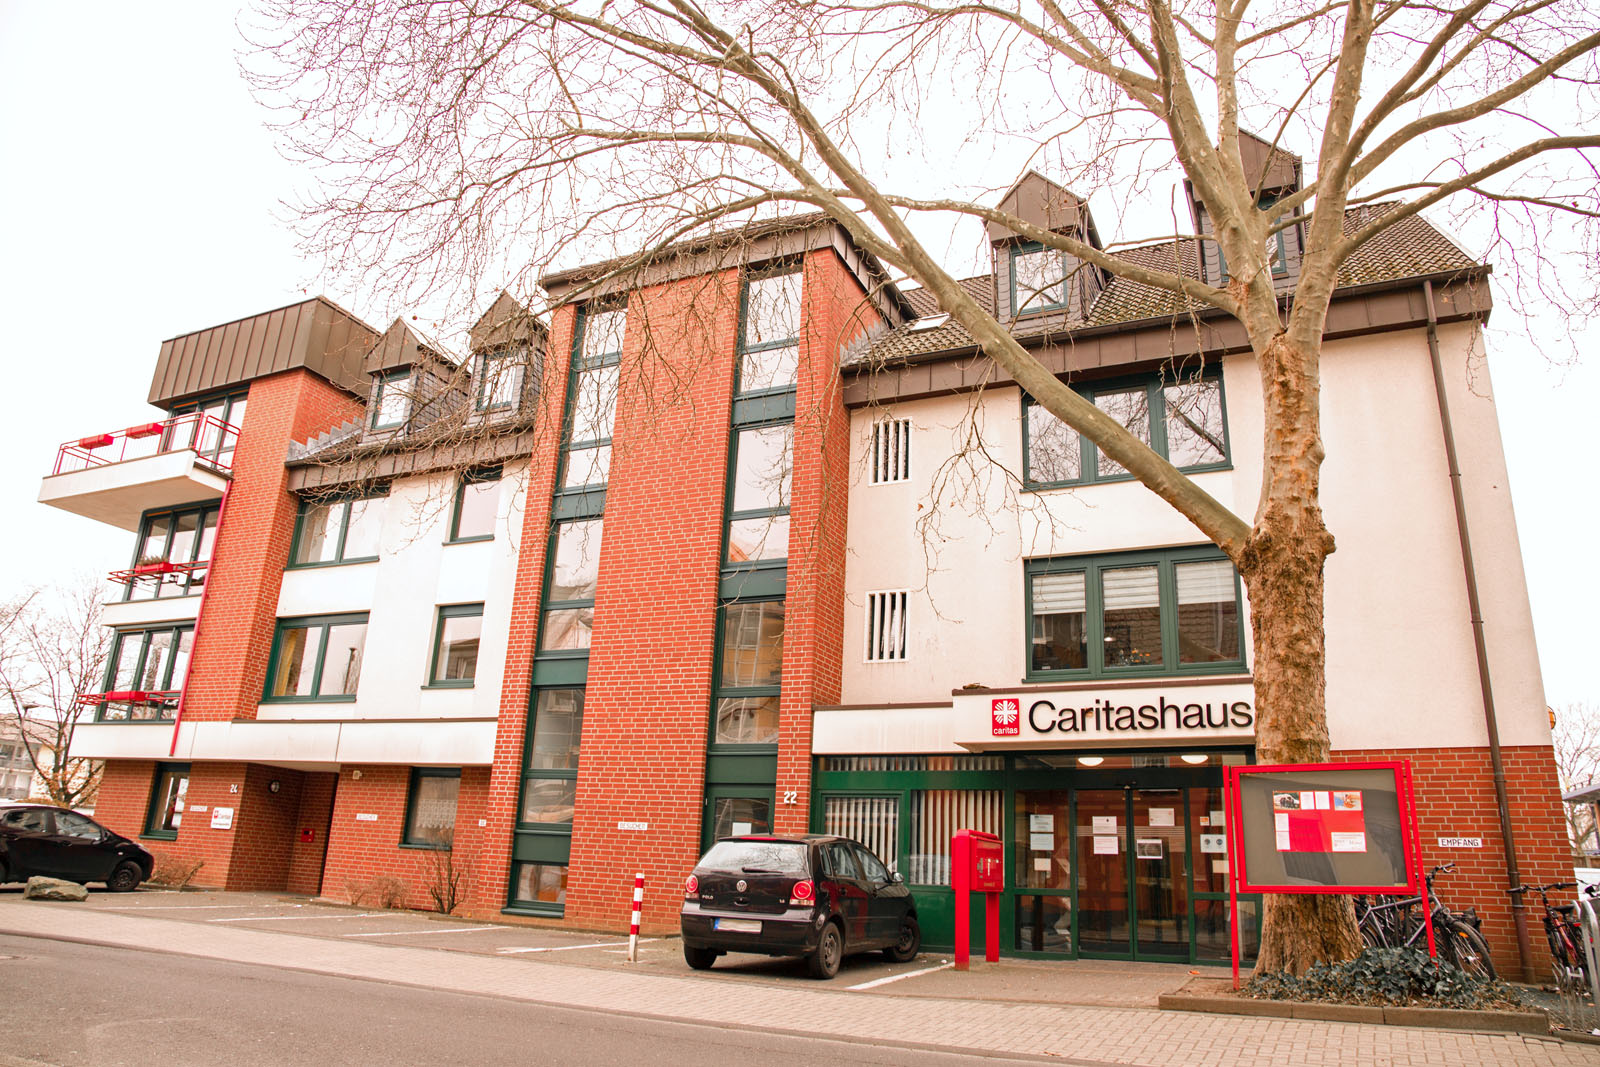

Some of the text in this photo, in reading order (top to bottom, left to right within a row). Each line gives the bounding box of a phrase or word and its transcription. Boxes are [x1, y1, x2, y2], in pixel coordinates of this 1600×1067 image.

[1029, 696, 1253, 733] Caritashaus
[993, 727, 1018, 735] caritas
[783, 791, 797, 803] 22
